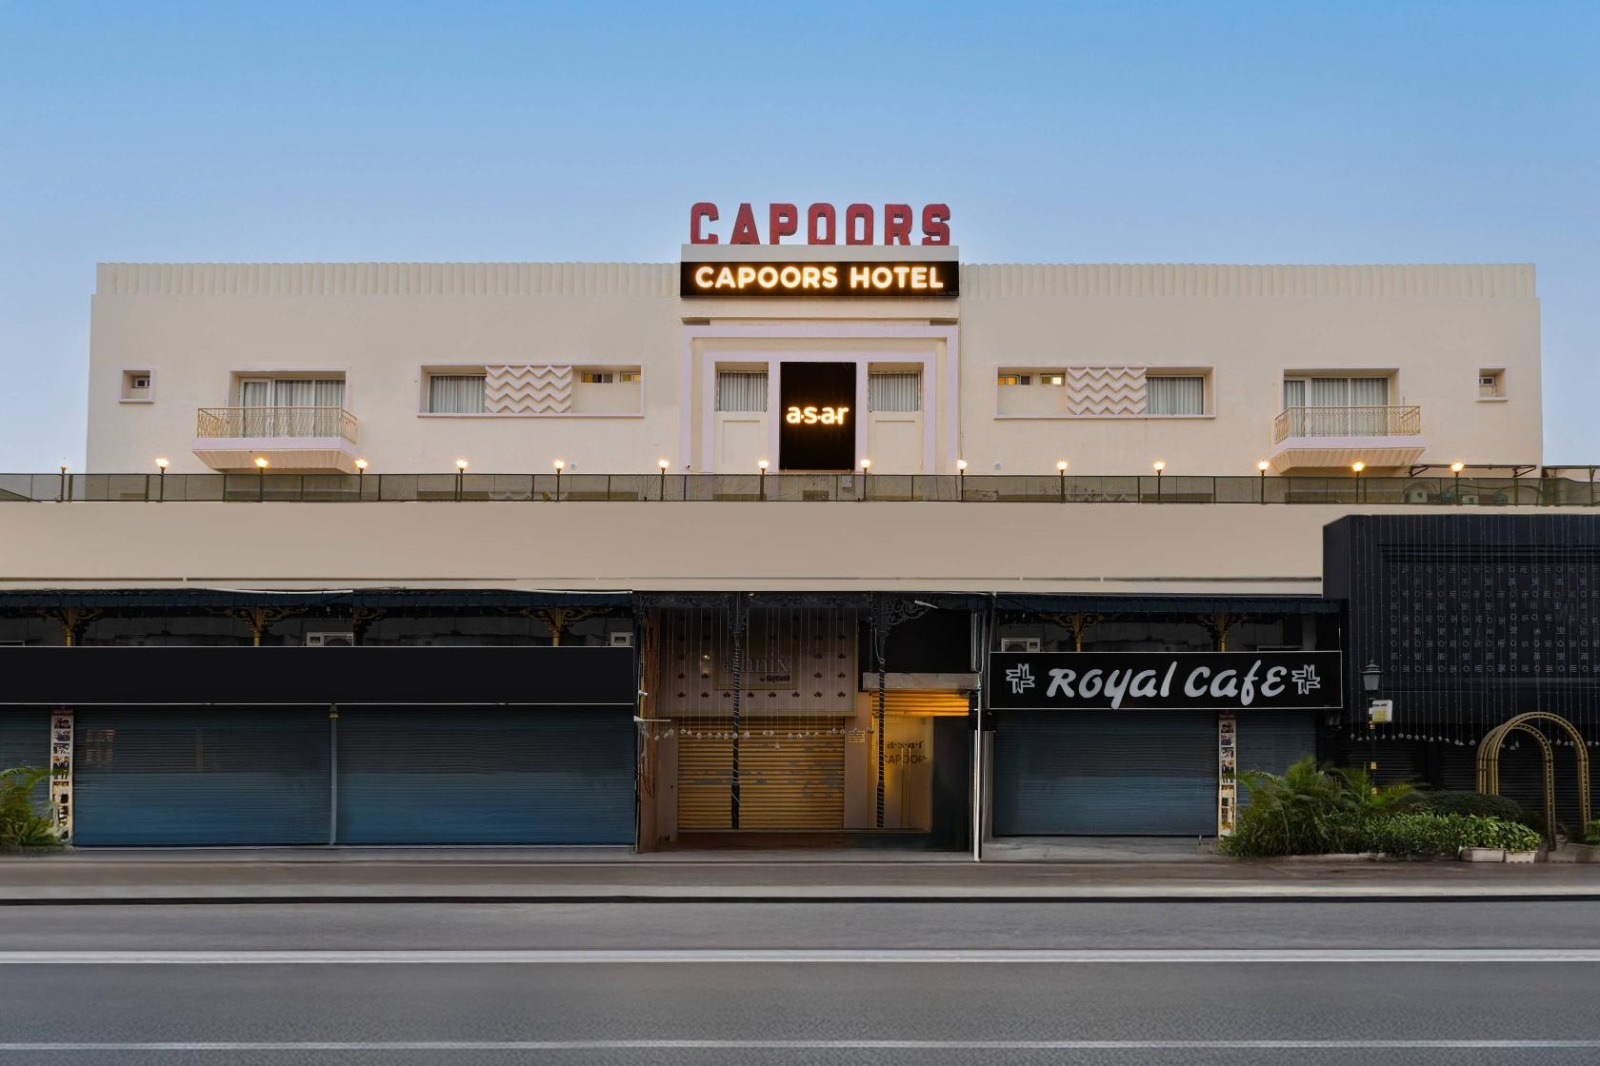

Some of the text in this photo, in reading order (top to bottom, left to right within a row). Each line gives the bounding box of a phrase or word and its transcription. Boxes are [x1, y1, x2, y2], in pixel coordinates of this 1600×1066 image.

[690, 202, 950, 245] CAPOORS
[695, 266, 944, 288] CAPOORS HOTEL
[1046, 660, 1177, 709] Royal
